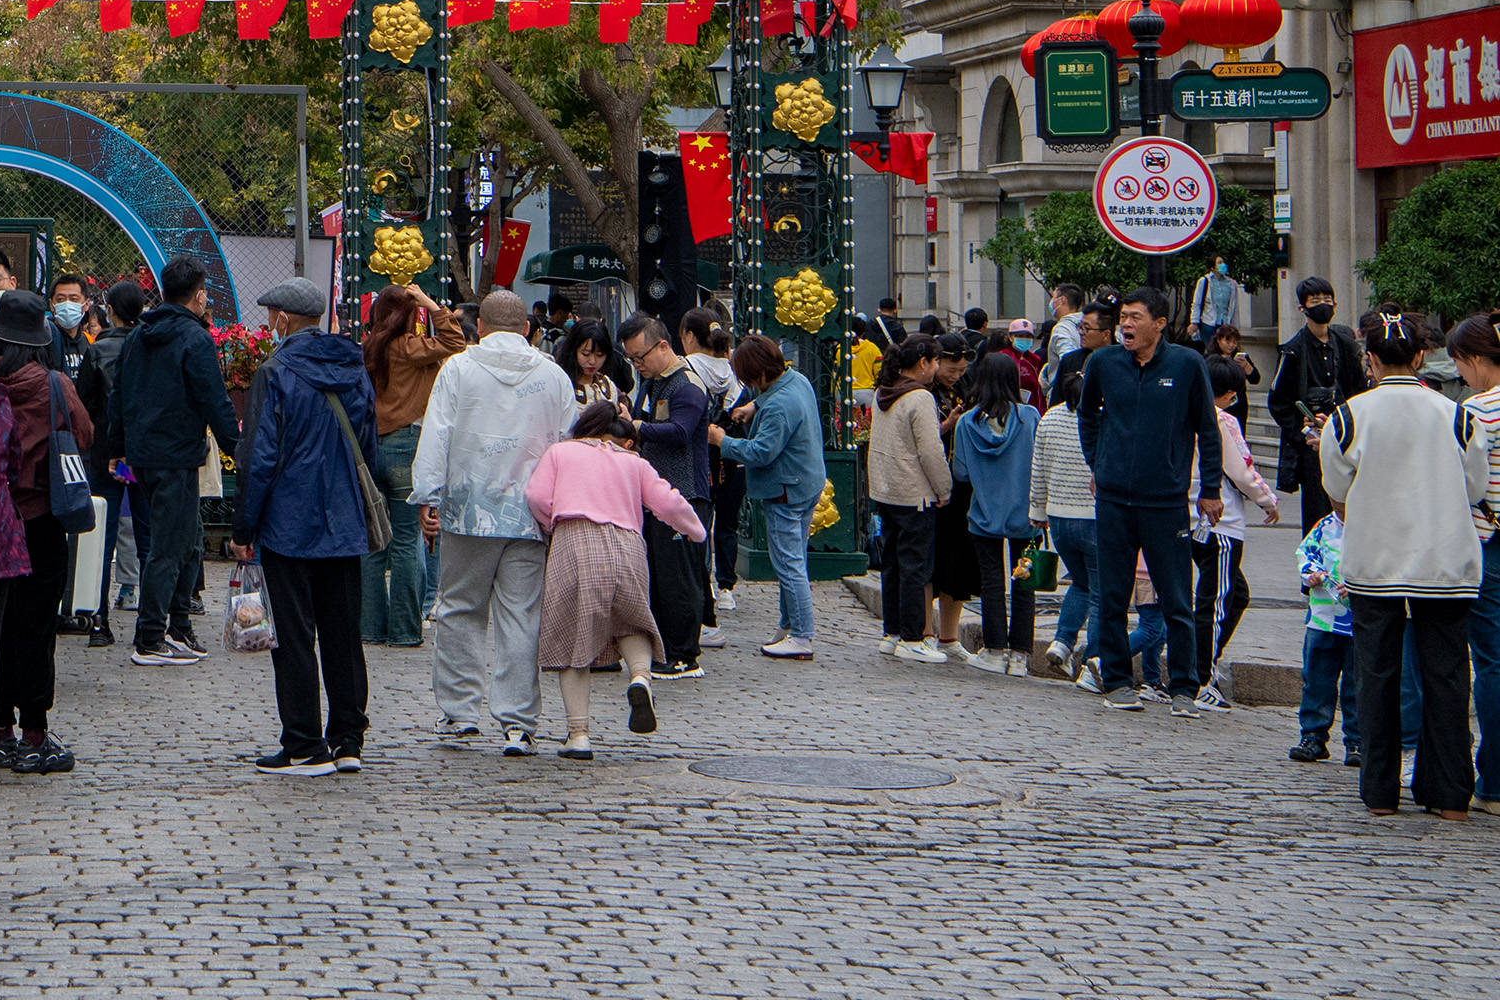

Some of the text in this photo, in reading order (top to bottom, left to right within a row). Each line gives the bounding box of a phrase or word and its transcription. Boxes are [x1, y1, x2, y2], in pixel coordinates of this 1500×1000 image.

[1181, 89, 1251, 108] 西十五道街
[1426, 121, 1453, 139] CHINA
[1108, 205, 1206, 217] 禁止机动车、非机动车等
[1115, 216, 1199, 228] 一切车辆和宠物入内
